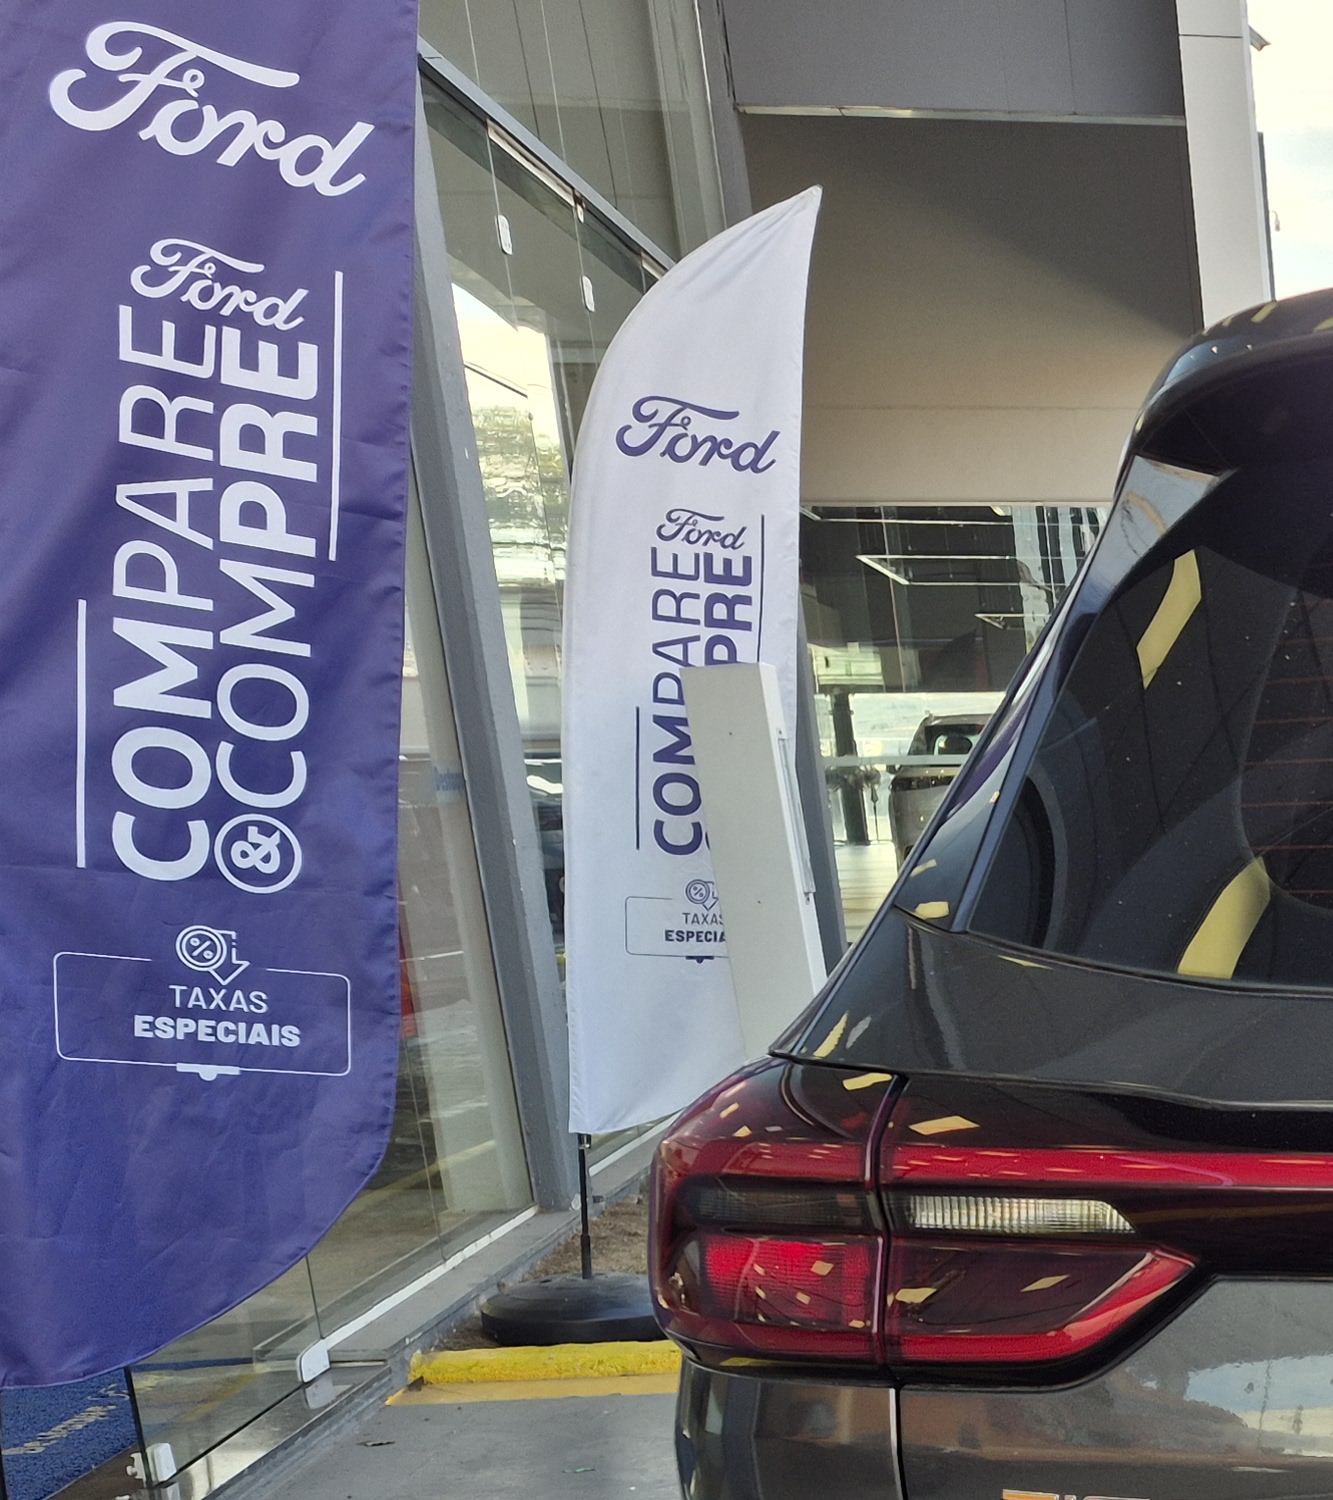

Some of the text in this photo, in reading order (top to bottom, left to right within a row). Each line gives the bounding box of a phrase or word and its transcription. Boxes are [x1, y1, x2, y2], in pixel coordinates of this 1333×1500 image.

[49, 21, 374, 198] Ford
[130, 238, 309, 330] Ford
[616, 394, 780, 474] Ford
[216, 325, 318, 809] COMPRE
[656, 508, 747, 551] Ford
[112, 304, 217, 881] COMPARE
[133, 1014, 301, 1047] ESPECIAIS
[168, 984, 269, 1014] TAXAS
